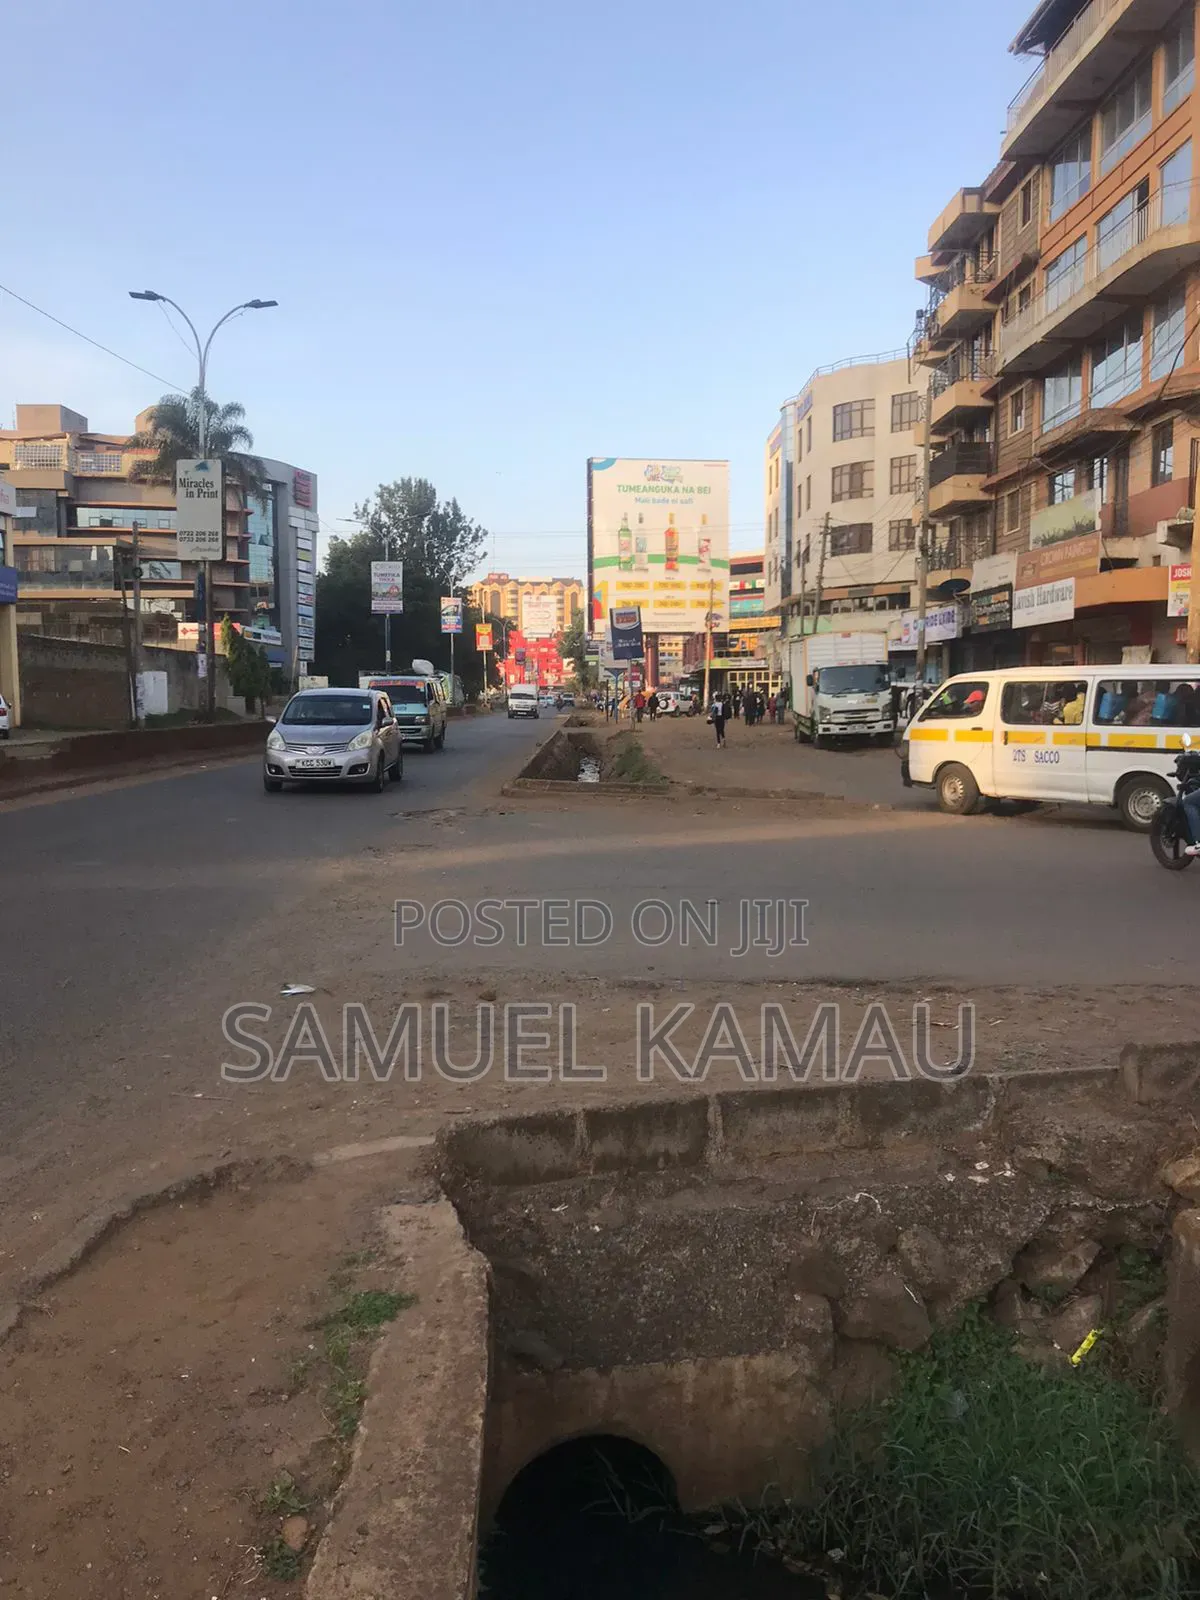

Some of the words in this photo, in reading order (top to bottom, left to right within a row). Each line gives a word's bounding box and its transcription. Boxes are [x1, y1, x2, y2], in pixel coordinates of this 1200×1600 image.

[179, 478, 214, 488] Miracles
[185, 488, 194, 498] in
[197, 488, 218, 498] Print
[617, 485, 680, 493] TUMEANGUKA
[682, 486, 695, 494] NA
[697, 486, 711, 494] BEI
[1013, 590, 1035, 610] Lavish
[1036, 584, 1073, 606] Hardware
[1034, 751, 1060, 764] SACCO
